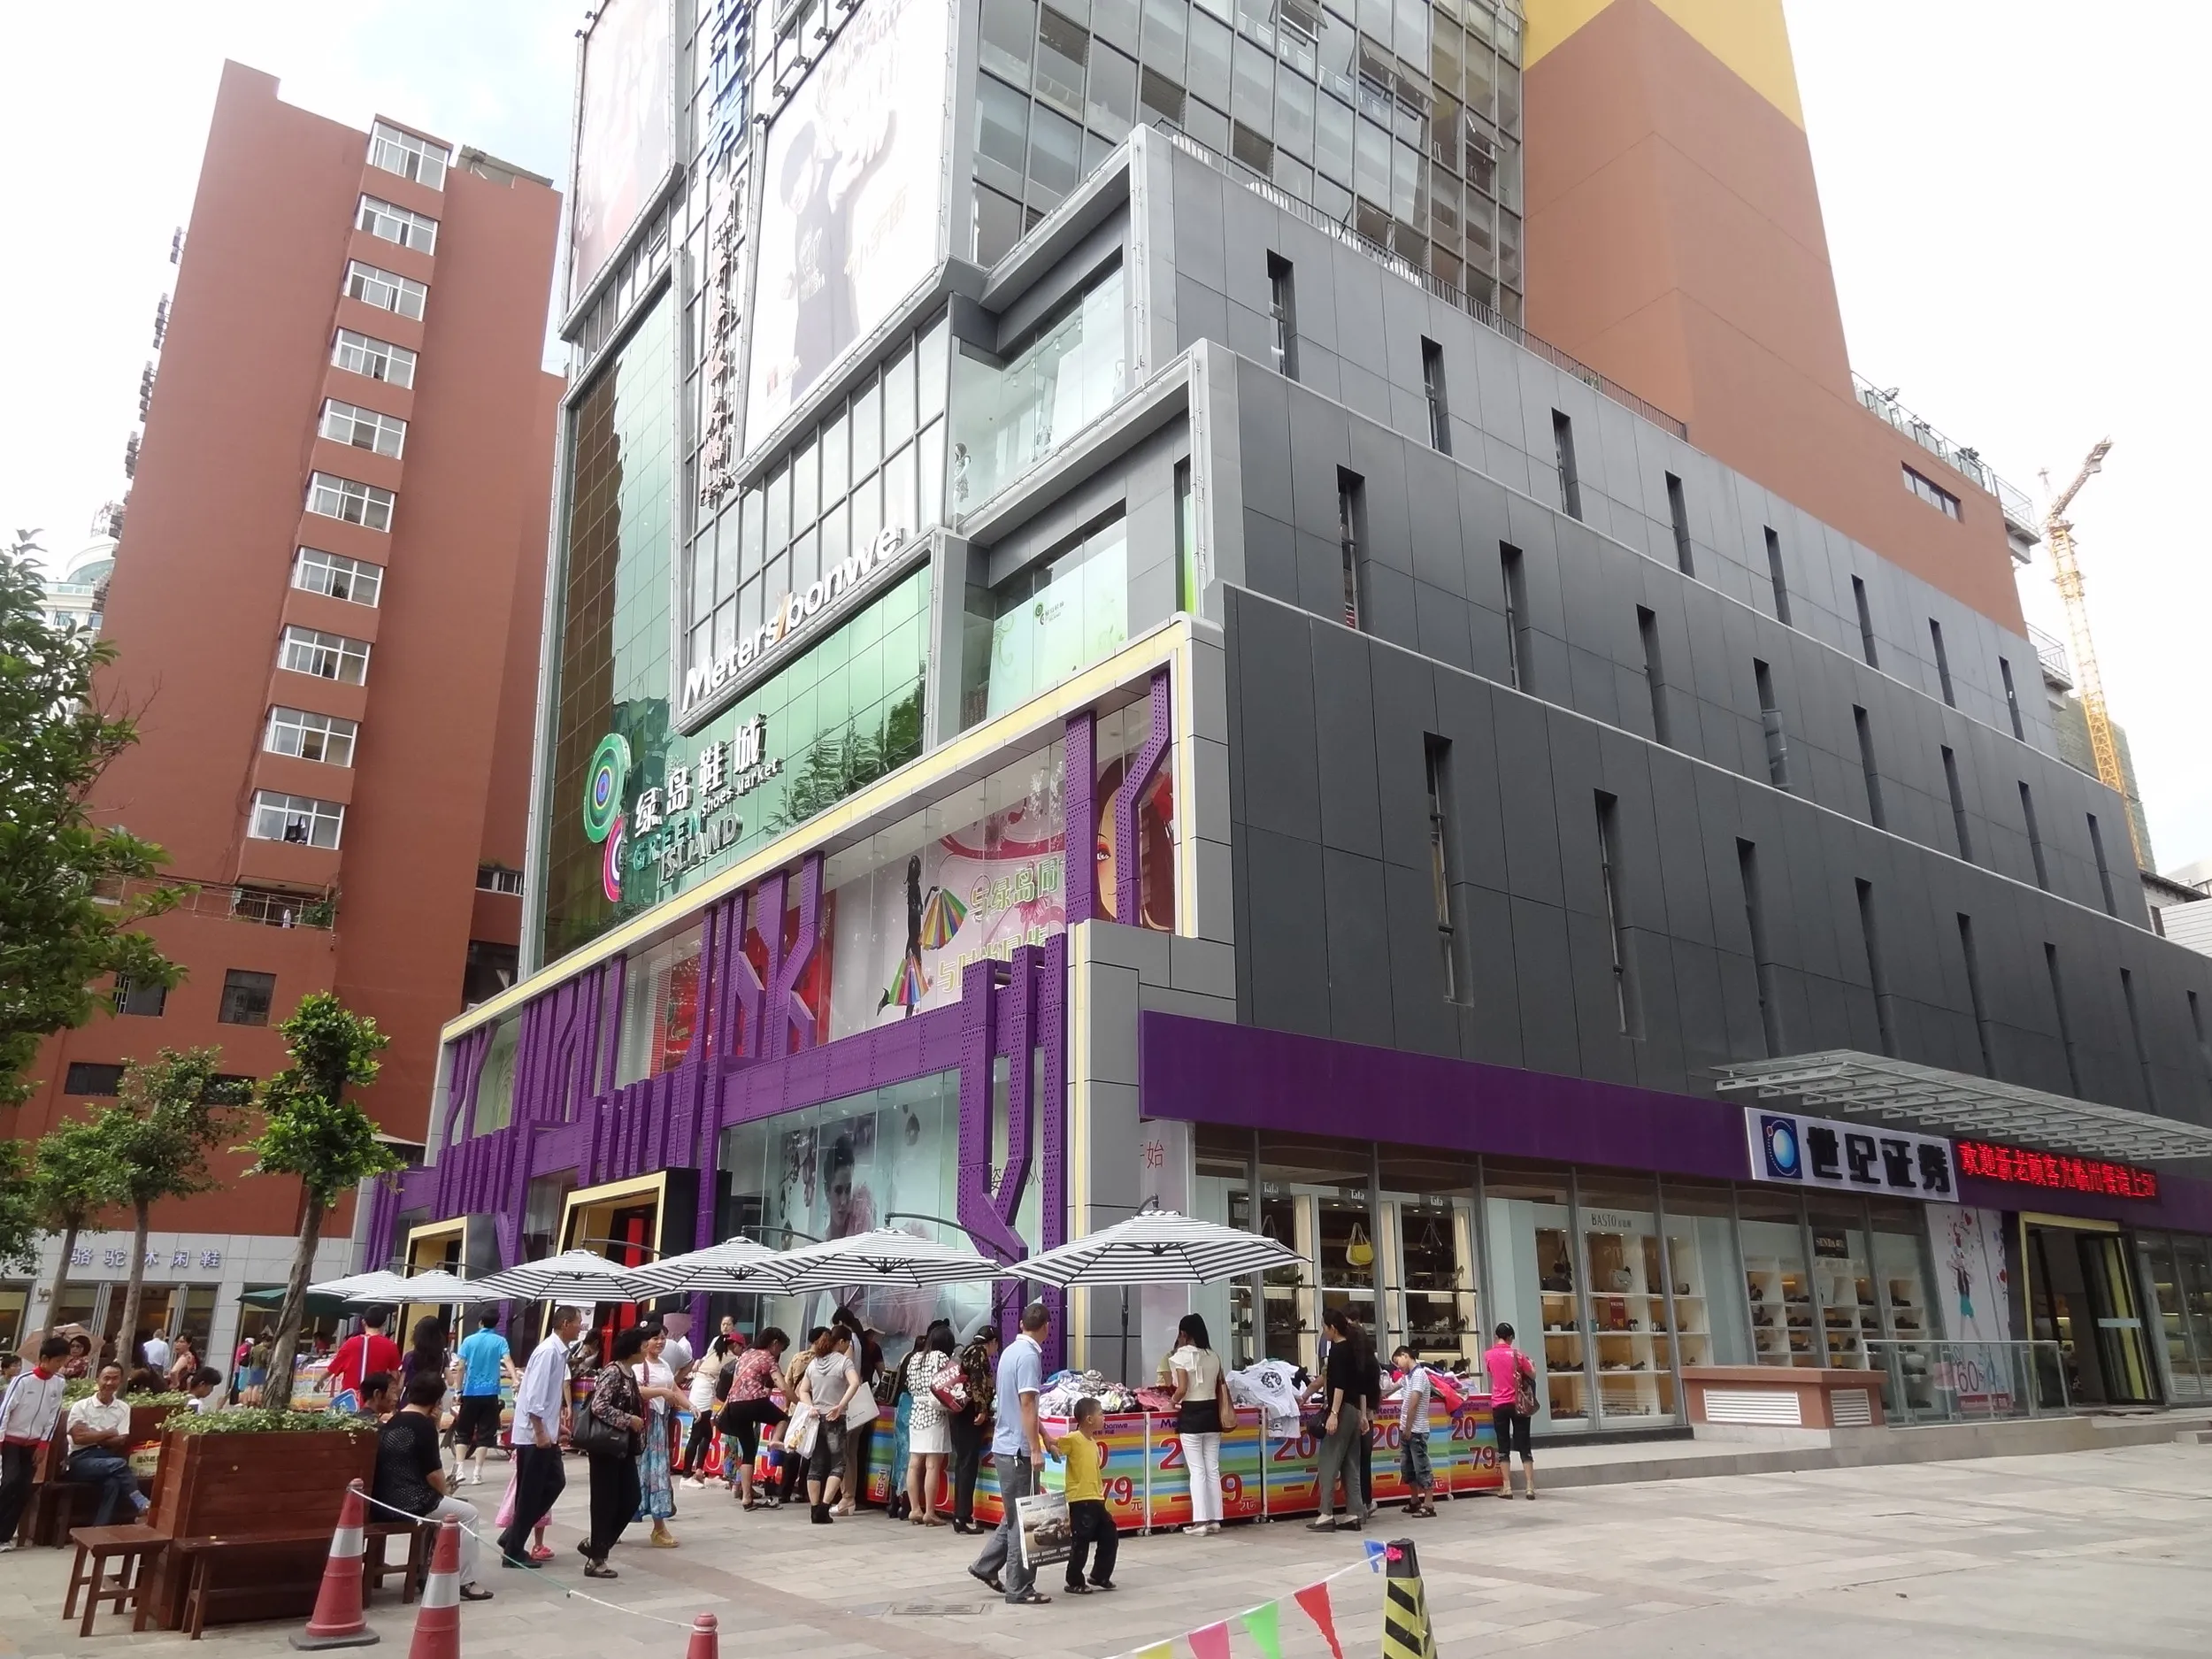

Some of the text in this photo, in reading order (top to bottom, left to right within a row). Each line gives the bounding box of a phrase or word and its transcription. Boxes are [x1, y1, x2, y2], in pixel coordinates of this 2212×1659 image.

[634, 712, 767, 838] 绿岛鞋城
[632, 810, 704, 872] GREEN
[658, 811, 742, 885] ISLAND
[969, 855, 1065, 922] 与绿岛同
[1140, 1139, 1164, 1169] 始
[1807, 1126, 1950, 1193] 世纪证券
[1591, 1213, 1617, 1227] BASTO
[70, 1246, 220, 1269] 骆驼休闲鞋
[1957, 1360, 1980, 1393] 60
[1371, 1422, 1402, 1452] 20
[1451, 1416, 1478, 1441] 20
[1273, 1430, 1317, 1462] 20
